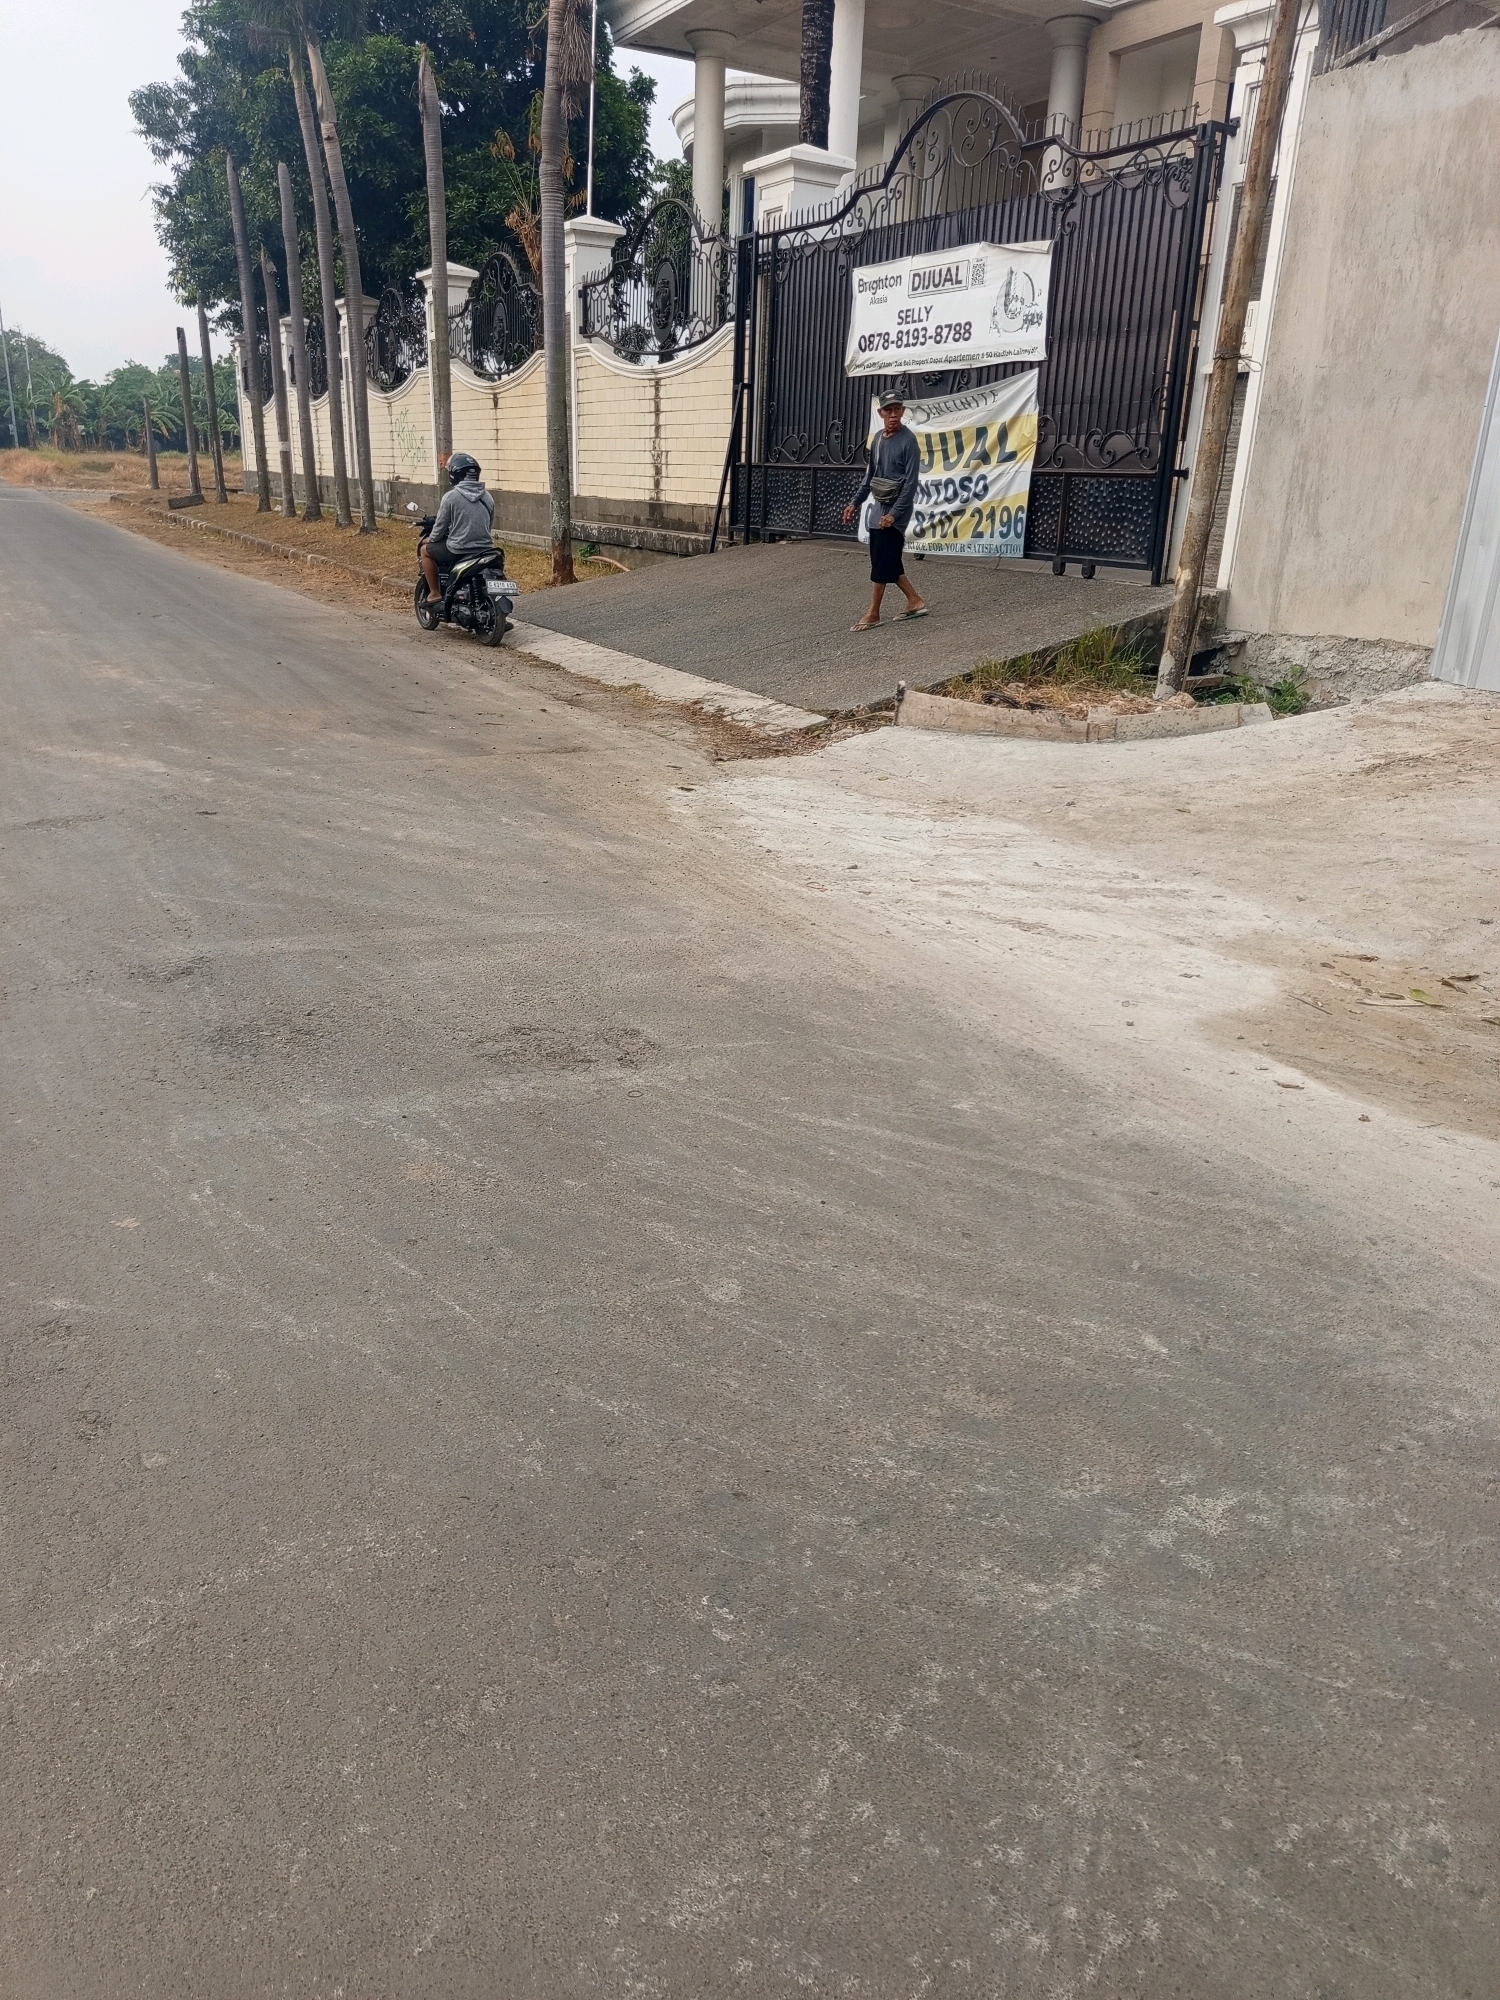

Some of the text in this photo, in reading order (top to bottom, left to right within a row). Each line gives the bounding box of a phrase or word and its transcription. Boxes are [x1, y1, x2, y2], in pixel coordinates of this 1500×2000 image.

[858, 274, 902, 295] Brighton
[912, 265, 963, 292] DIJUAL
[869, 295, 888, 305] Akasia
[897, 305, 934, 326] SELLY
[858, 321, 972, 353] 0878-8193-8788
[927, 389, 999, 416] INFINITE
[920, 421, 1018, 474] JUAL
[913, 474, 989, 505] NTOSO
[912, 505, 1025, 540] 8107 2196
[903, 540, 1022, 554] ERVICE FOR YOUR SATISFACTION
